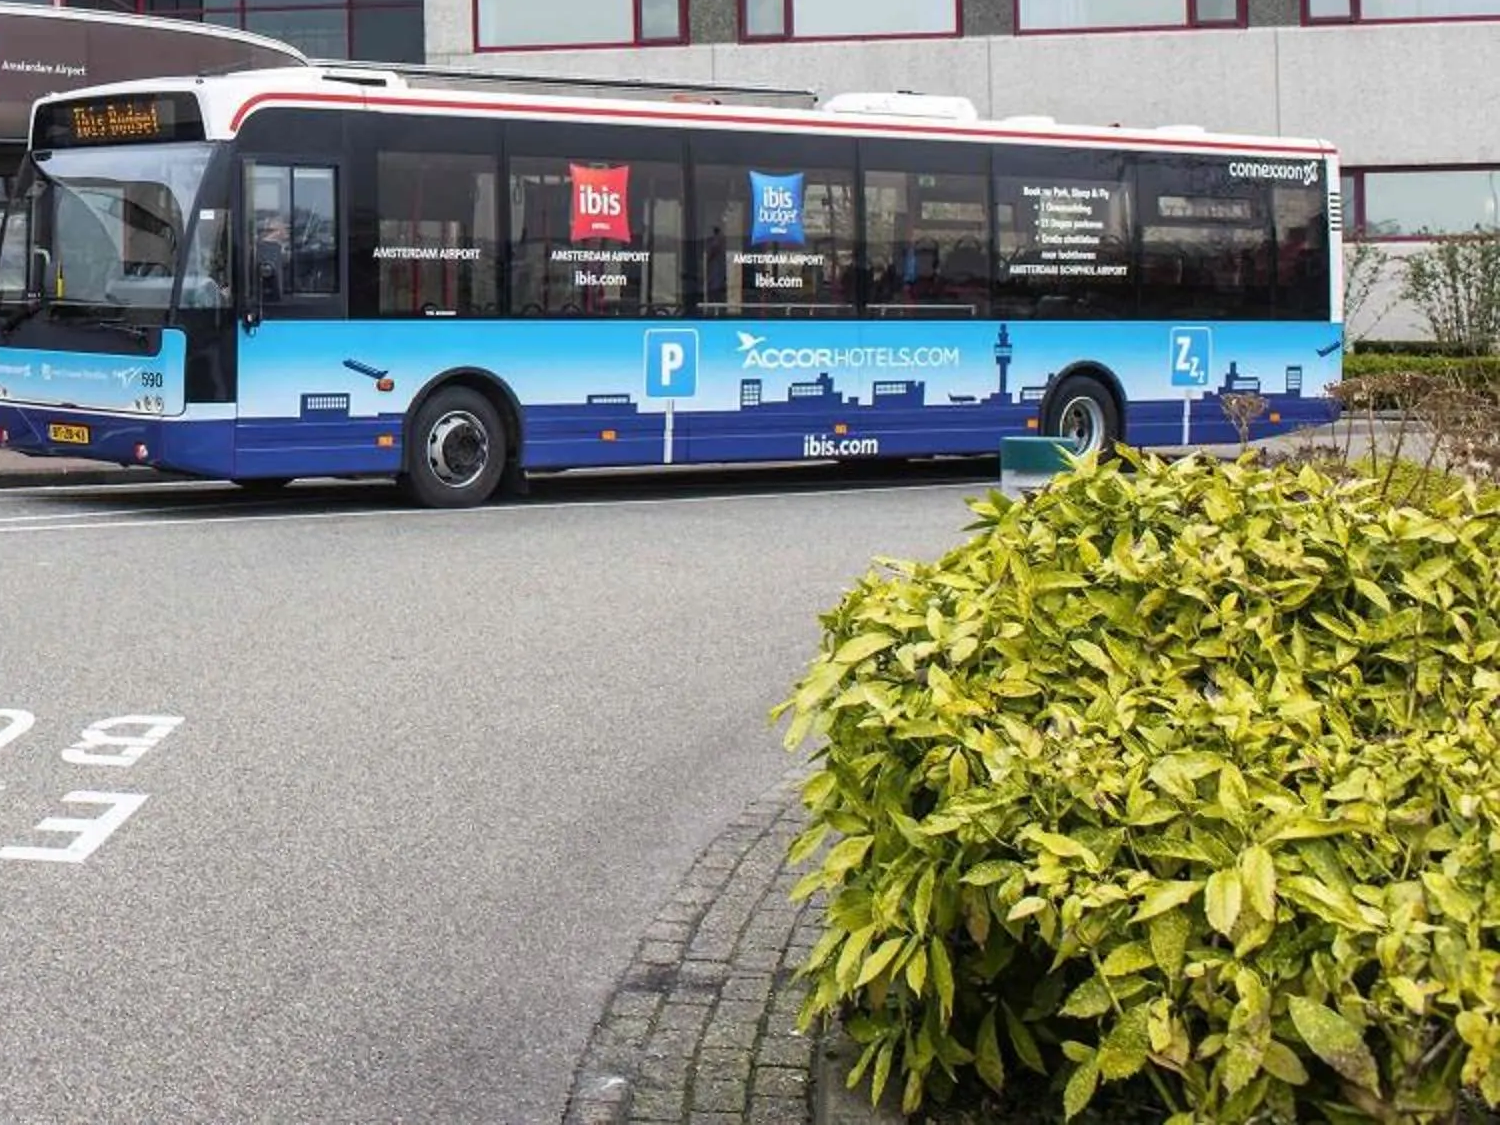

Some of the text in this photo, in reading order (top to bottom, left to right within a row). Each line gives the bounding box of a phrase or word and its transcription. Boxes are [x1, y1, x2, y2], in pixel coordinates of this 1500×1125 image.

[1, 59, 88, 78] Amsterdam Airport
[579, 183, 621, 216] ibis
[763, 186, 794, 208] ibis
[759, 206, 798, 226] budget
[372, 247, 481, 260] AMSTERDAM AIRPORT
[551, 250, 650, 263] AMSTERDAM AIRPORT
[733, 253, 824, 266] AMSTERDAM AIRPORT
[575, 270, 627, 286] ibis.com
[755, 272, 803, 288] ibis.com
[660, 341, 685, 387] P
[742, 346, 960, 369] ACCORHOTELS.COM
[141, 372, 164, 388] 590
[803, 435, 880, 457] ibis.com
